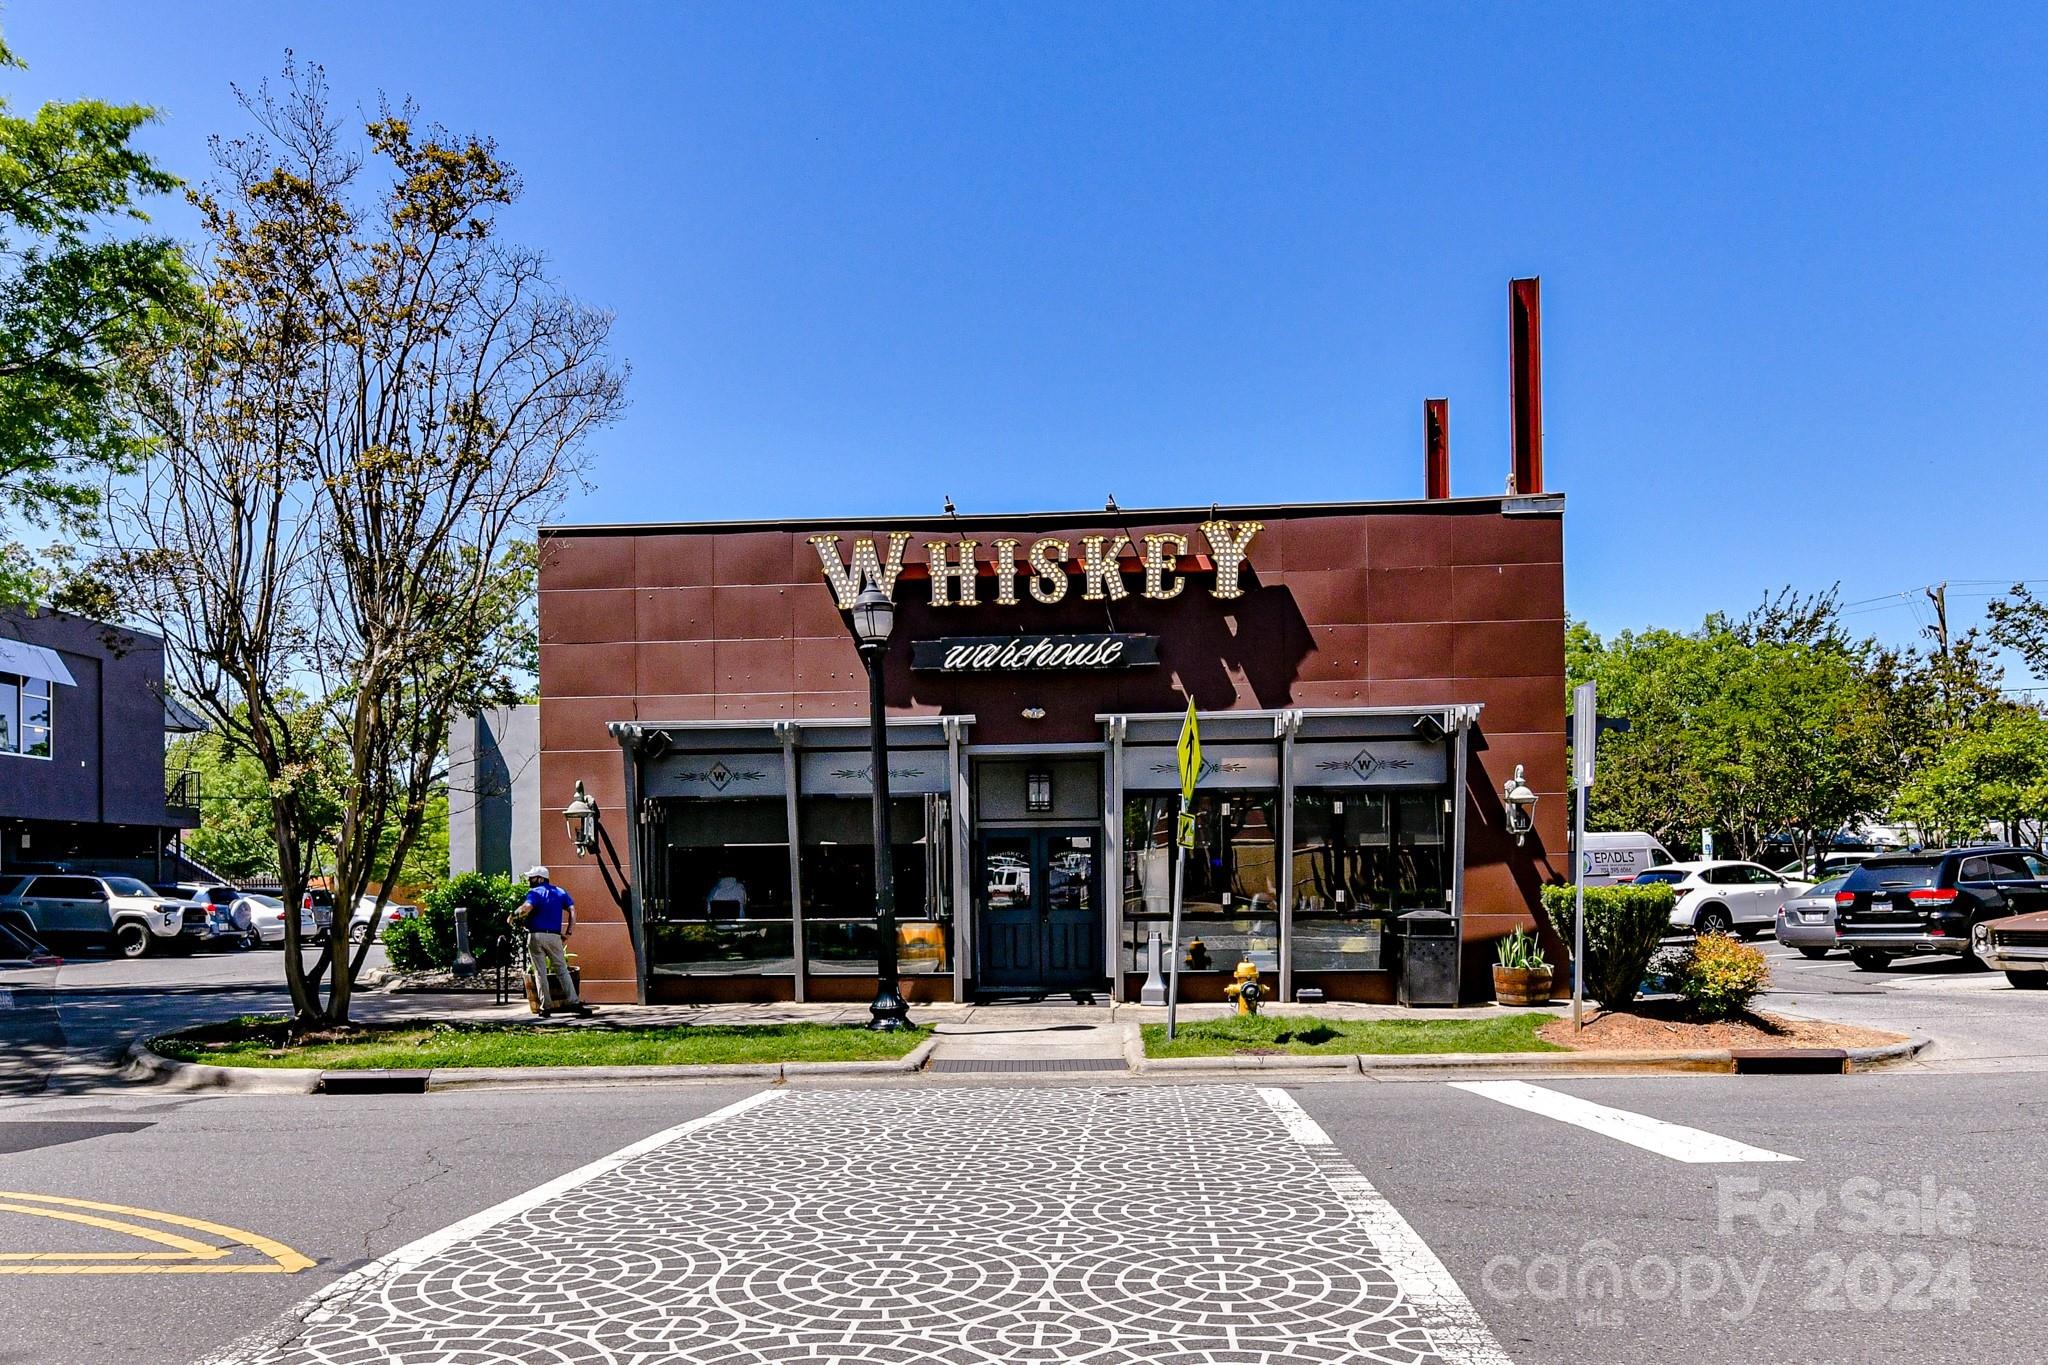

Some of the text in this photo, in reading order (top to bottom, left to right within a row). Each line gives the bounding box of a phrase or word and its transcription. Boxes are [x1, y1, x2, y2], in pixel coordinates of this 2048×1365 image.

[806, 520, 1266, 609] WHISKEY
[944, 637, 1126, 669] warehouse
[1357, 760, 1372, 770] W
[713, 772, 726, 781] W
